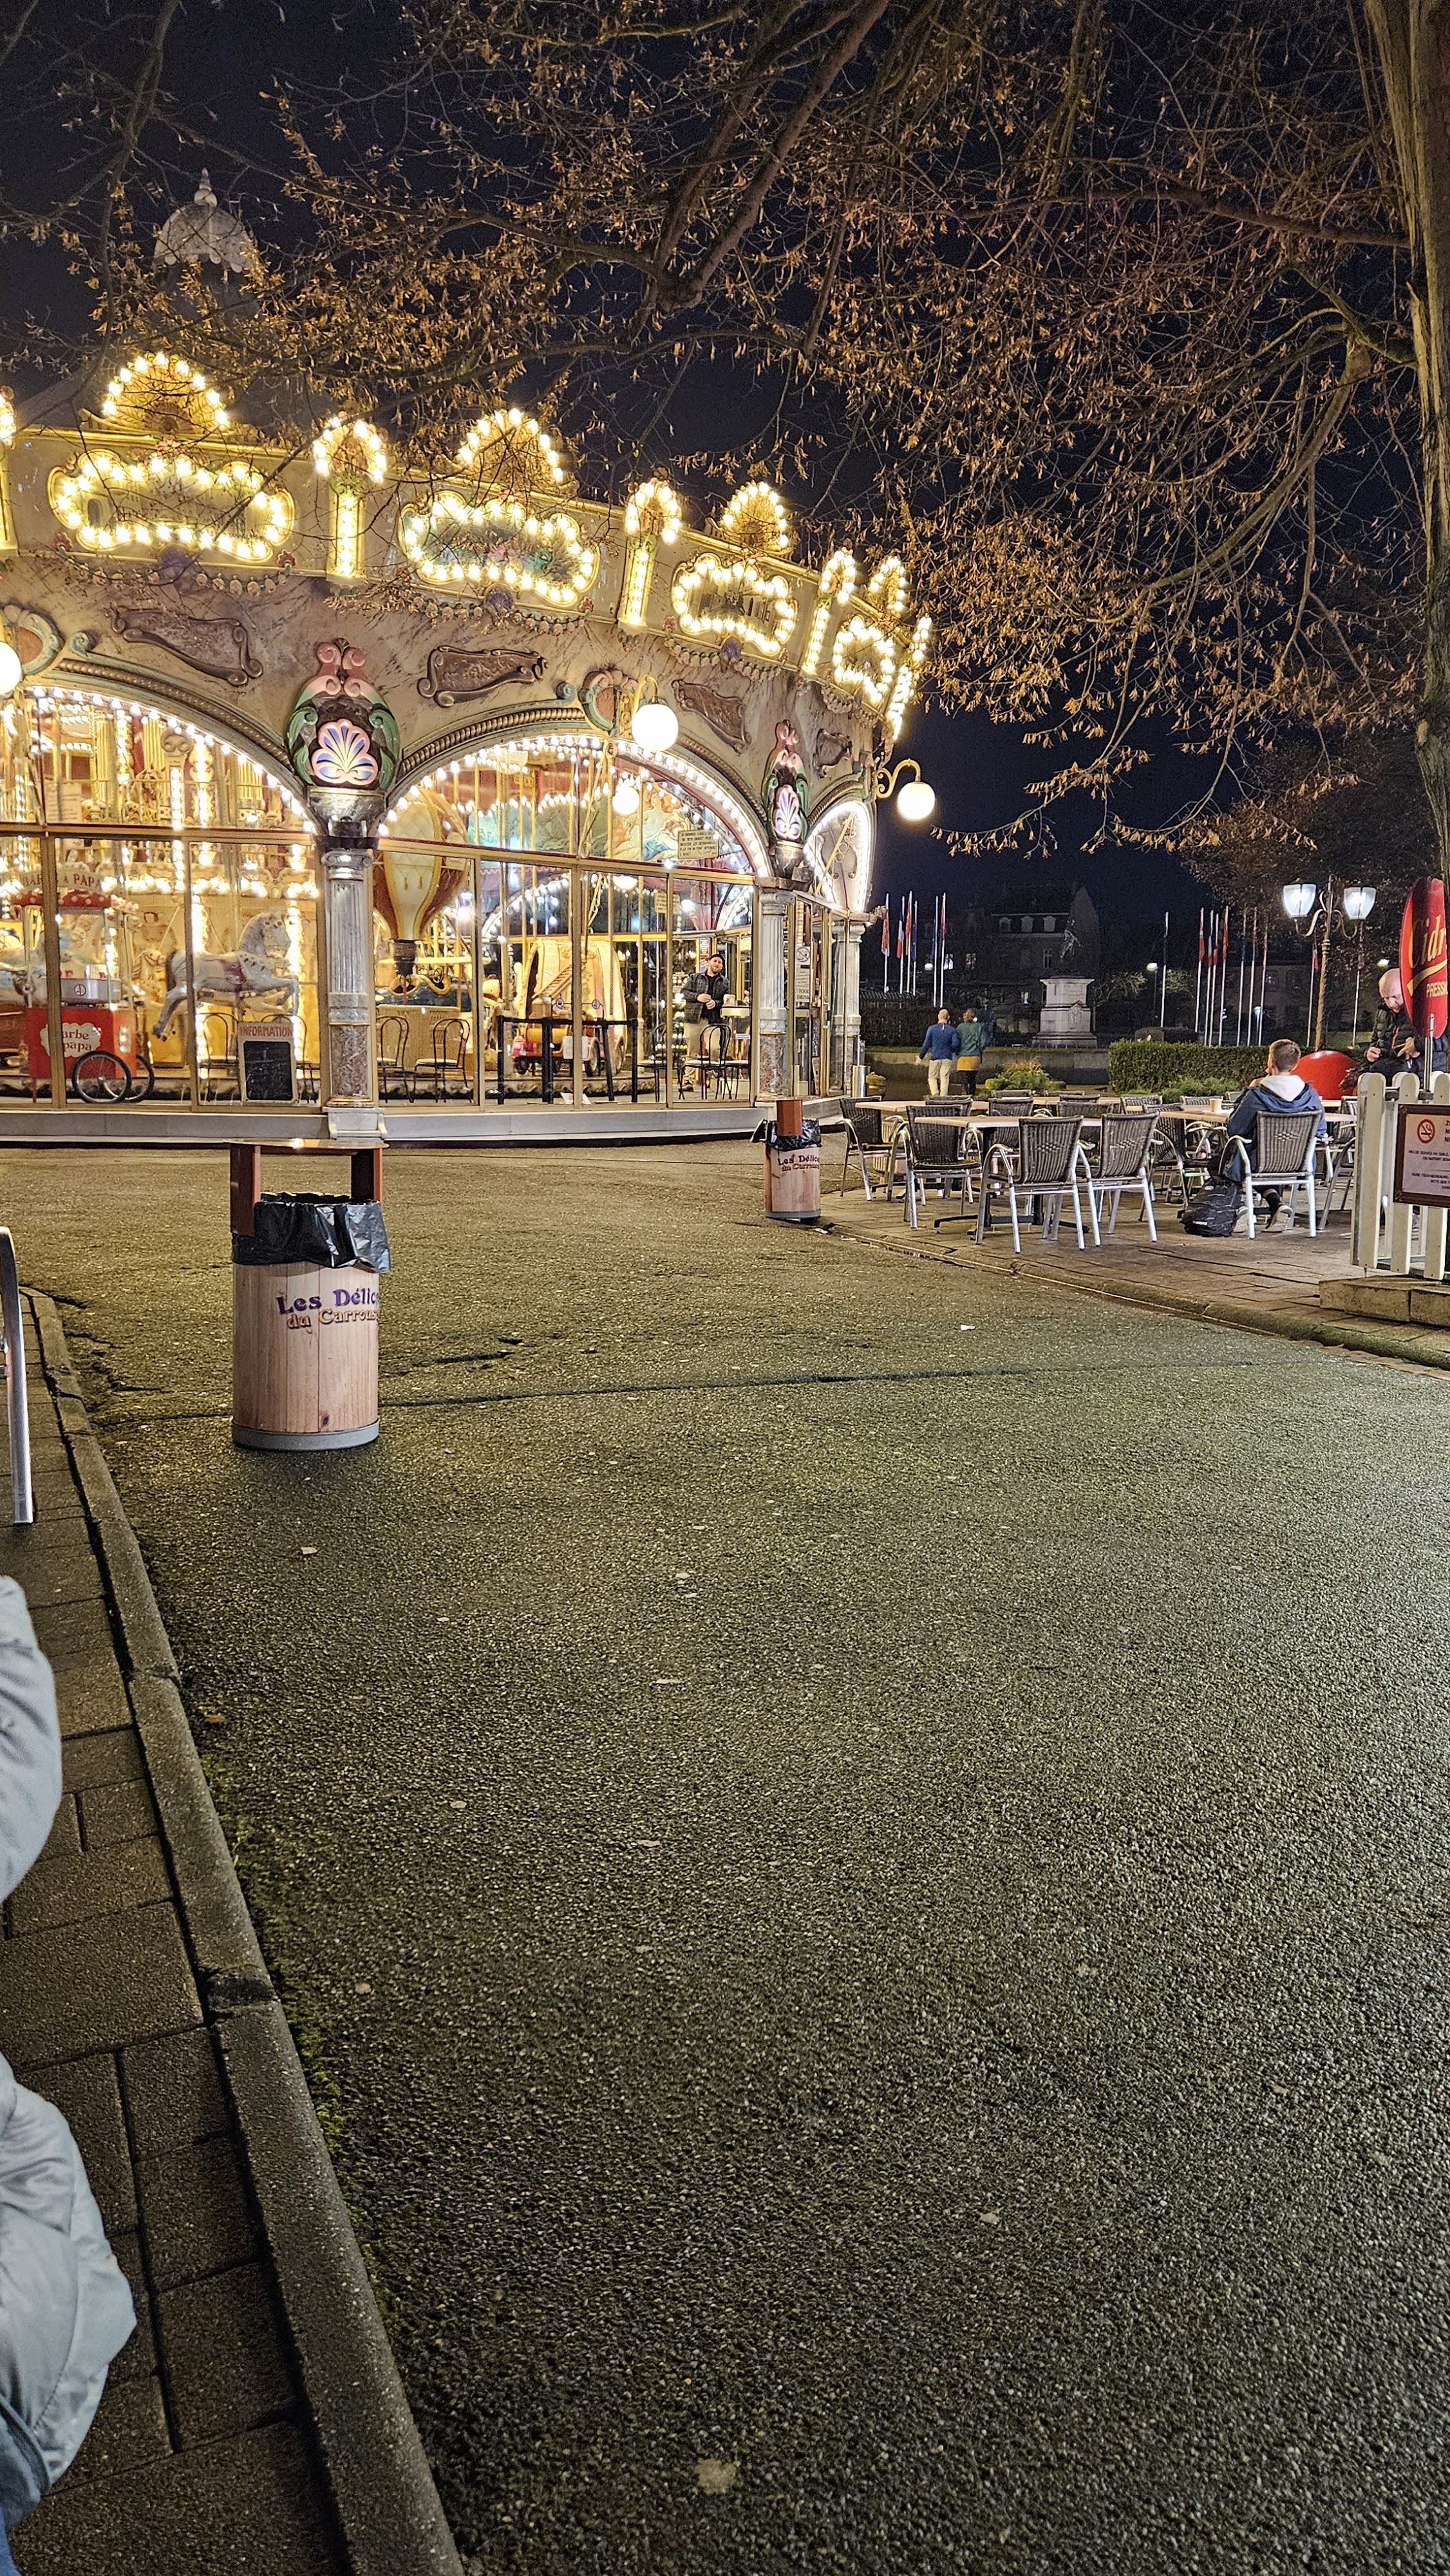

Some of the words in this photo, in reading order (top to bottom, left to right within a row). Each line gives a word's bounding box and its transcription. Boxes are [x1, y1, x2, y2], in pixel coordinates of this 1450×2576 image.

[1408, 914, 1447, 969] Cidr
[62, 1029, 89, 1040] arbe
[240, 1025, 292, 1037] INFORMATION
[276, 1295, 322, 1315] Les
[287, 1312, 312, 1330] du
